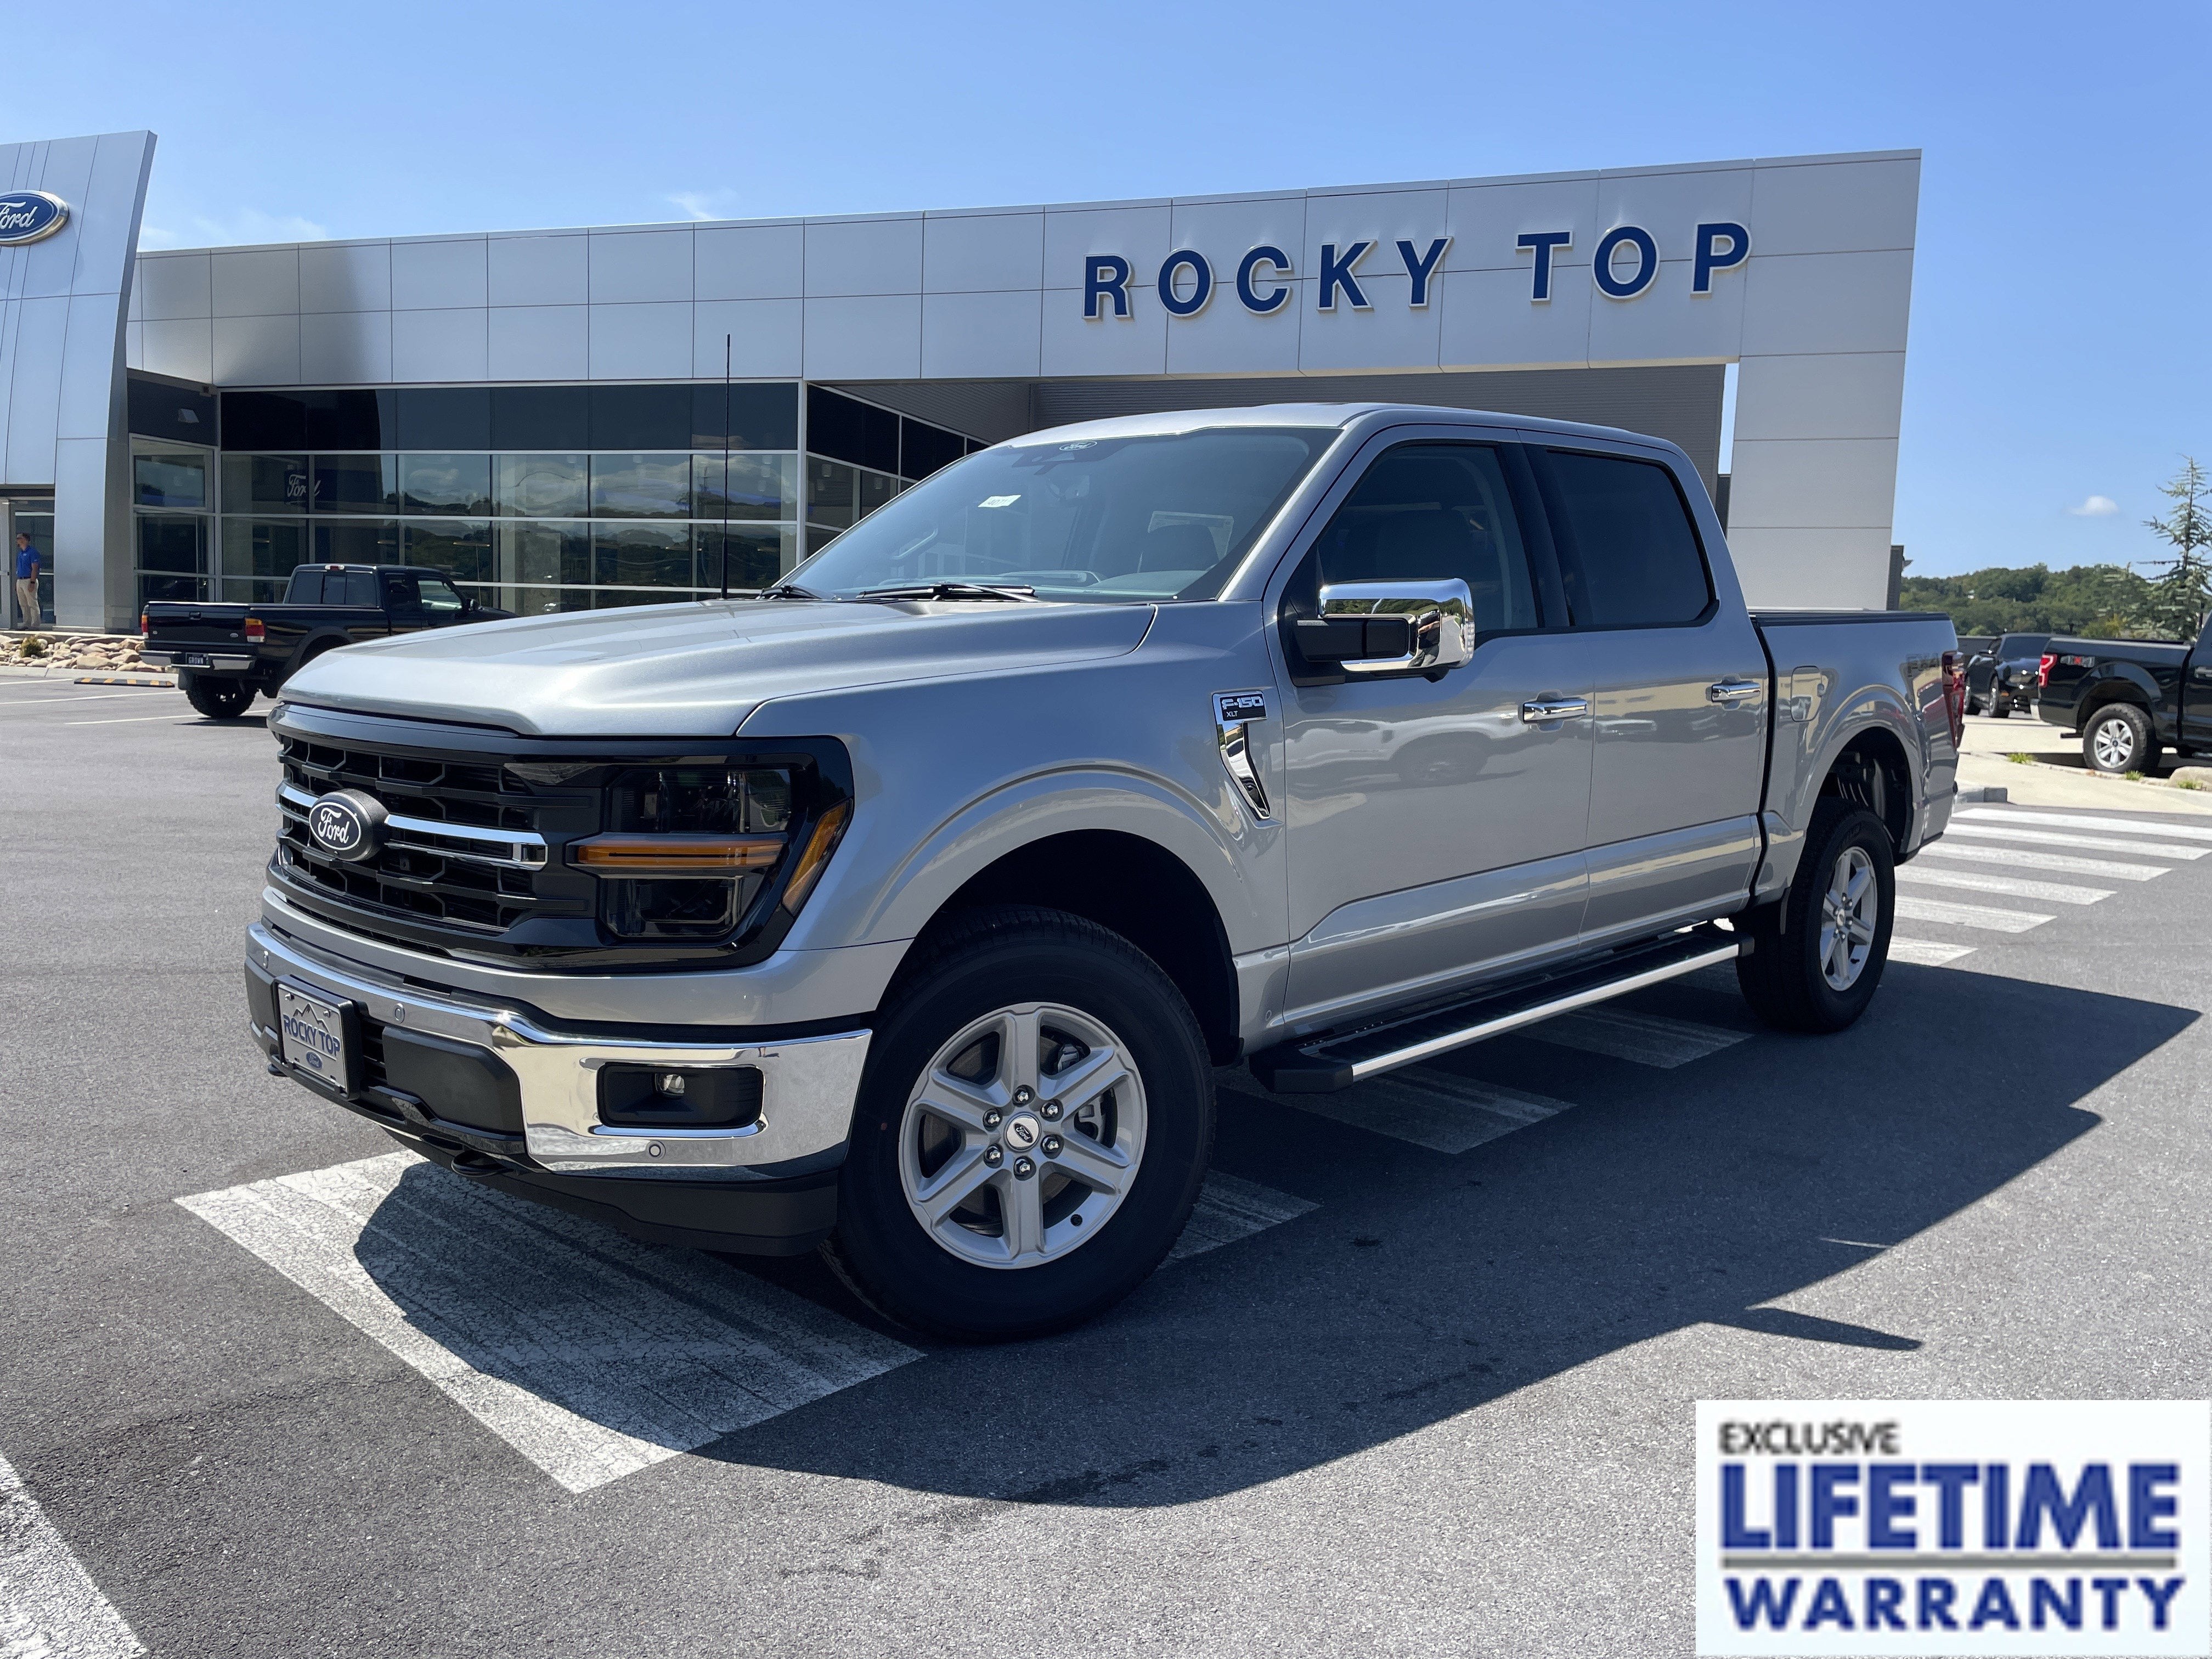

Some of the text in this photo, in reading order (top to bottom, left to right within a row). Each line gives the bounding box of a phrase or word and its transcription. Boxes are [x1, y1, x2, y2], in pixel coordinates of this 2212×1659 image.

[1083, 221, 1752, 319] ROCKY TOP
[1221, 696, 1264, 710] F-150
[318, 807, 350, 844] Ford
[283, 1014, 341, 1057] ROCKY TOP
[1015, 1126, 1031, 1141] Ford
